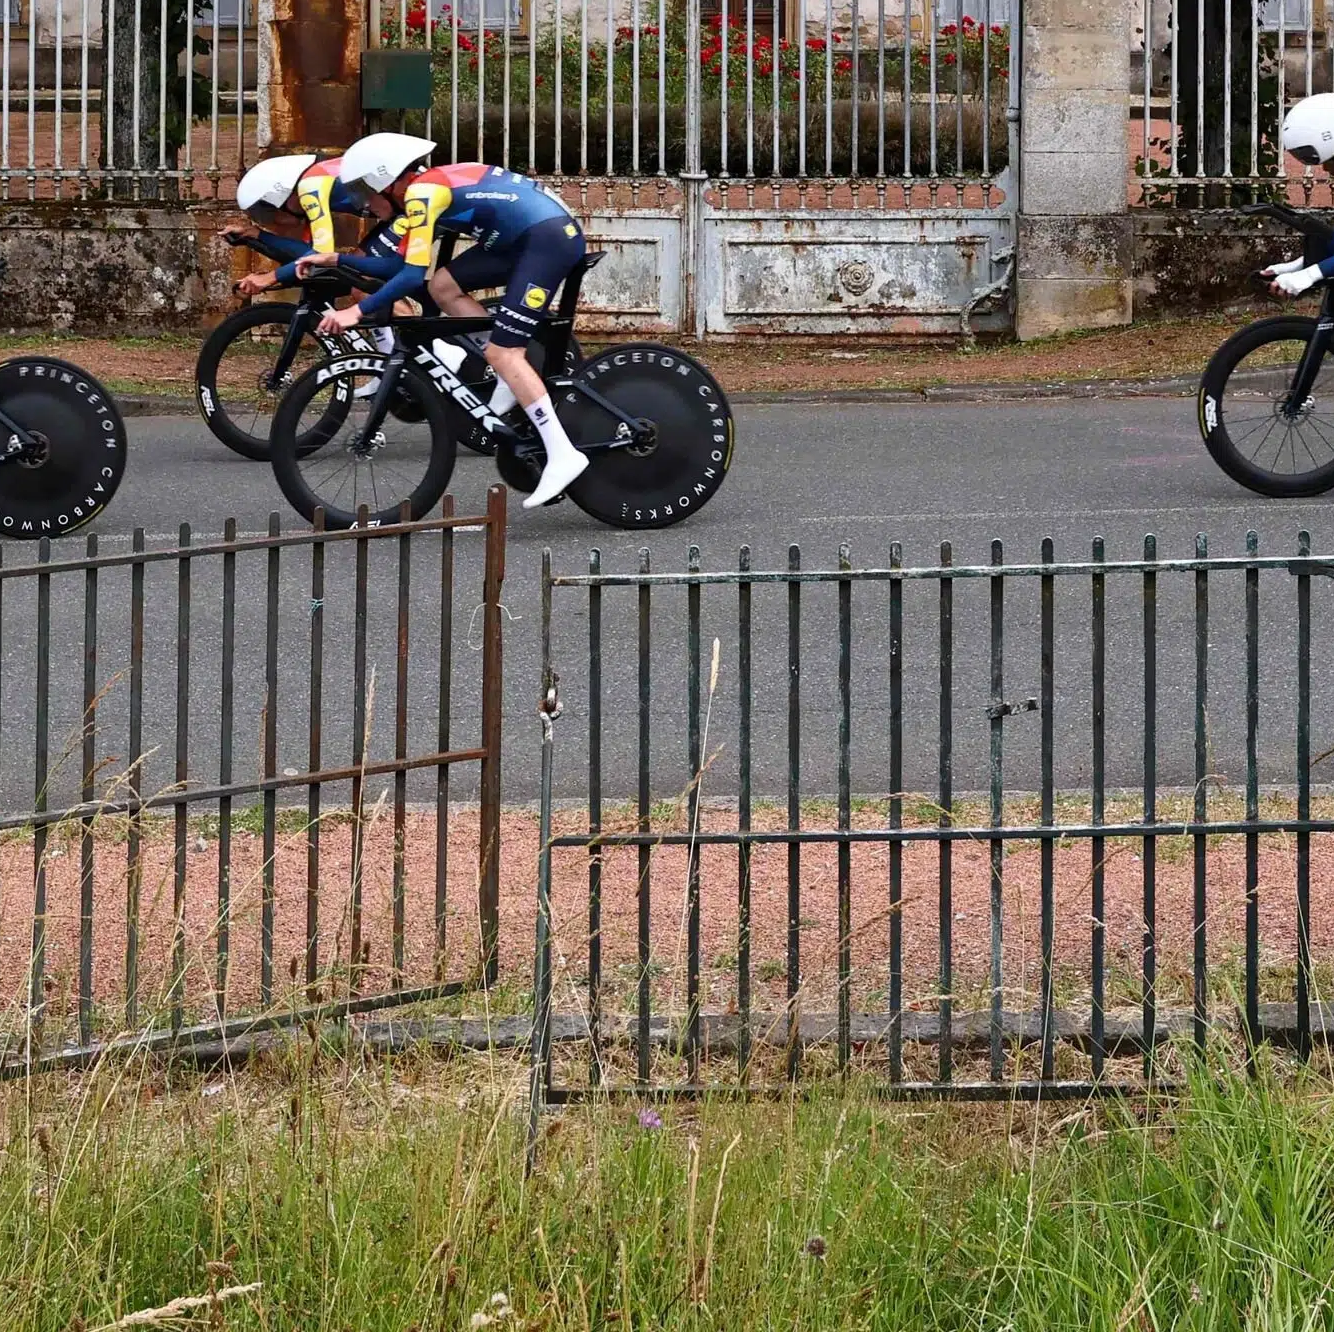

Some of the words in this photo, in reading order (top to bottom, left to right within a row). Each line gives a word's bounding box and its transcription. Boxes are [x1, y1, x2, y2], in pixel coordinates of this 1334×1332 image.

[500, 305, 539, 326] TREK
[19, 366, 117, 449] PRINCETON
[413, 345, 507, 433] TREK
[635, 385, 726, 520] CARBONWORKS
